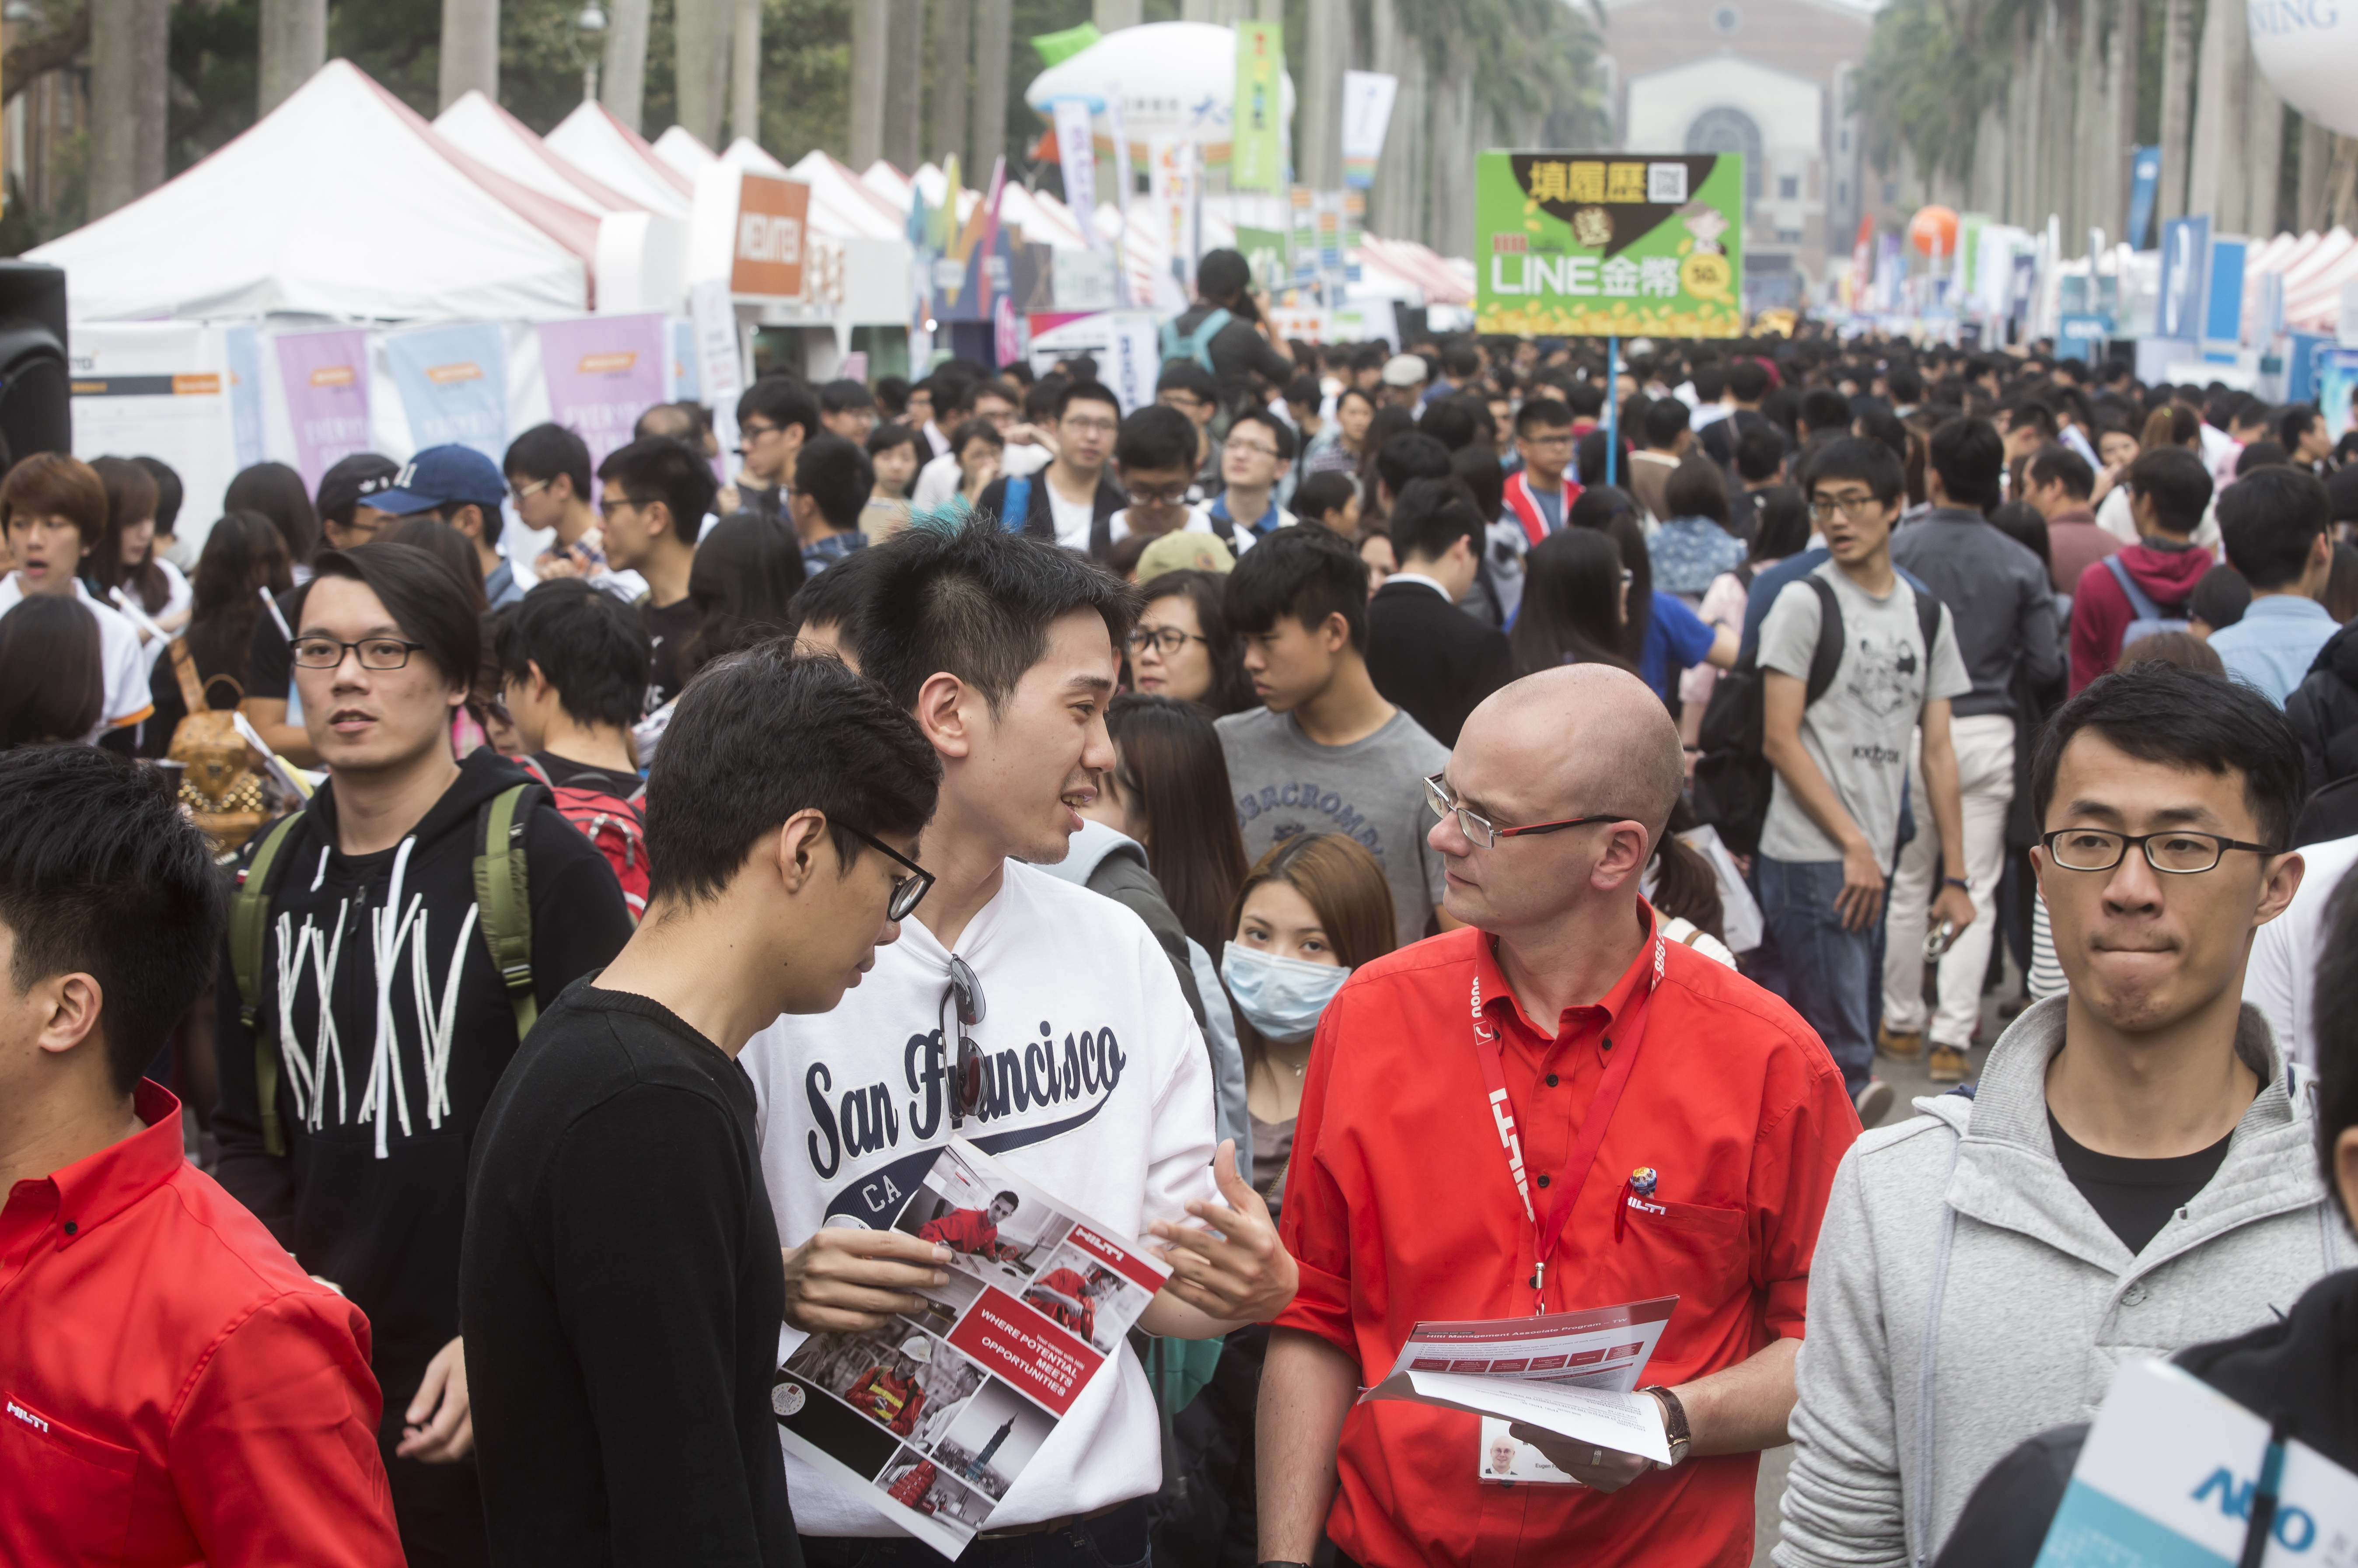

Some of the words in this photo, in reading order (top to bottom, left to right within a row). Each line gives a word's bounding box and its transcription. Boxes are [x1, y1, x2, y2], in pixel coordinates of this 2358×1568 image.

[1529, 161, 1647, 203] 填履歷
[806, 1061, 899, 1180] San
[862, 1175, 901, 1212] CA
[1075, 1226, 1125, 1262] HILTI
[981, 1308, 1021, 1340] WHERE
[1020, 1333, 1077, 1379] POTENTIAL
[1561, 1323, 1601, 1331] Program
[982, 1336, 1066, 1397] OPPORTUNITIES
[1036, 1357, 1073, 1388] MEETS
[6, 1401, 49, 1433] HILTI
